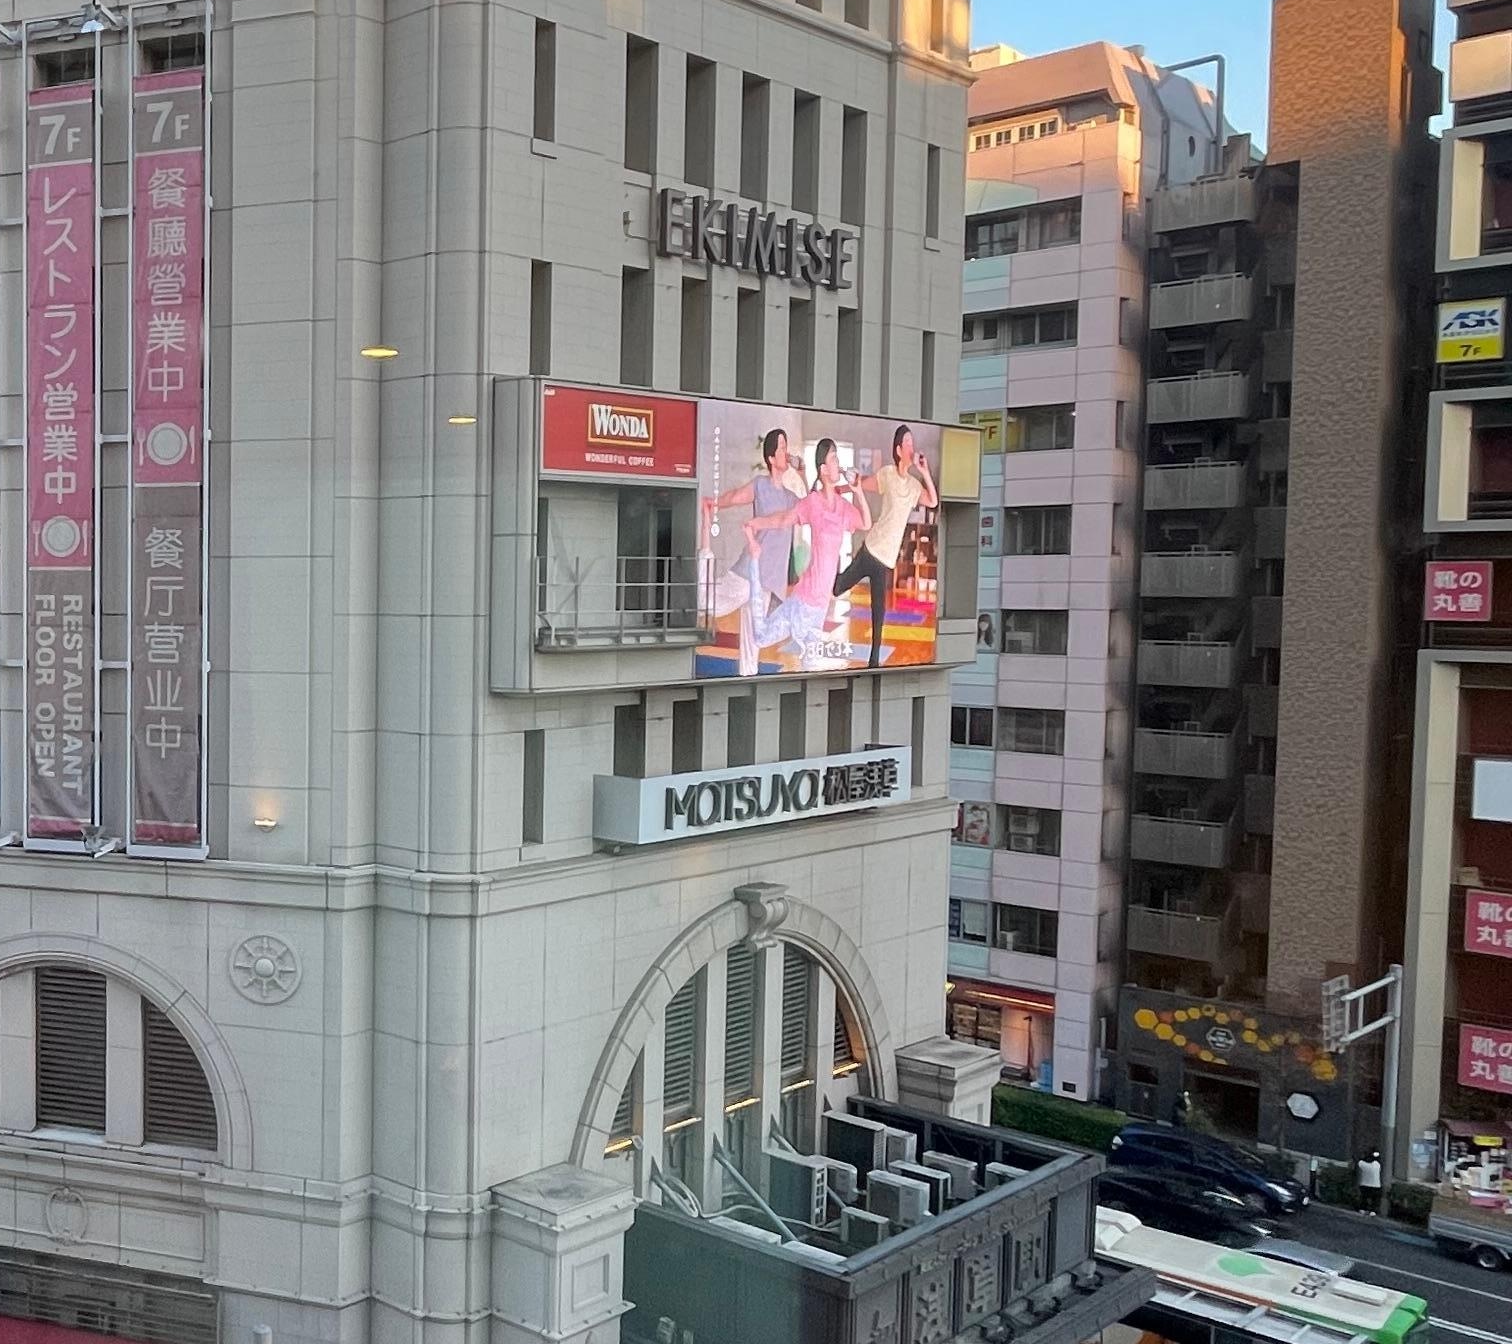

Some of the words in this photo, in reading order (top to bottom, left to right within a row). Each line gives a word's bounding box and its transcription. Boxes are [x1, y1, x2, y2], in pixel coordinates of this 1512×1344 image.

[38, 114, 82, 155] 7F
[146, 101, 190, 144] 7F
[146, 166, 188, 403] 餐廳營業中
[660, 187, 855, 291] EKIMISE
[42, 176, 79, 505] レストラン営業中
[35, 594, 56, 685] FLOOR
[144, 525, 185, 759] 餐厅营业中
[34, 702, 56, 779] OPEN
[61, 594, 83, 796] RESTAURANT
[1478, 901, 1512, 923] 靴
